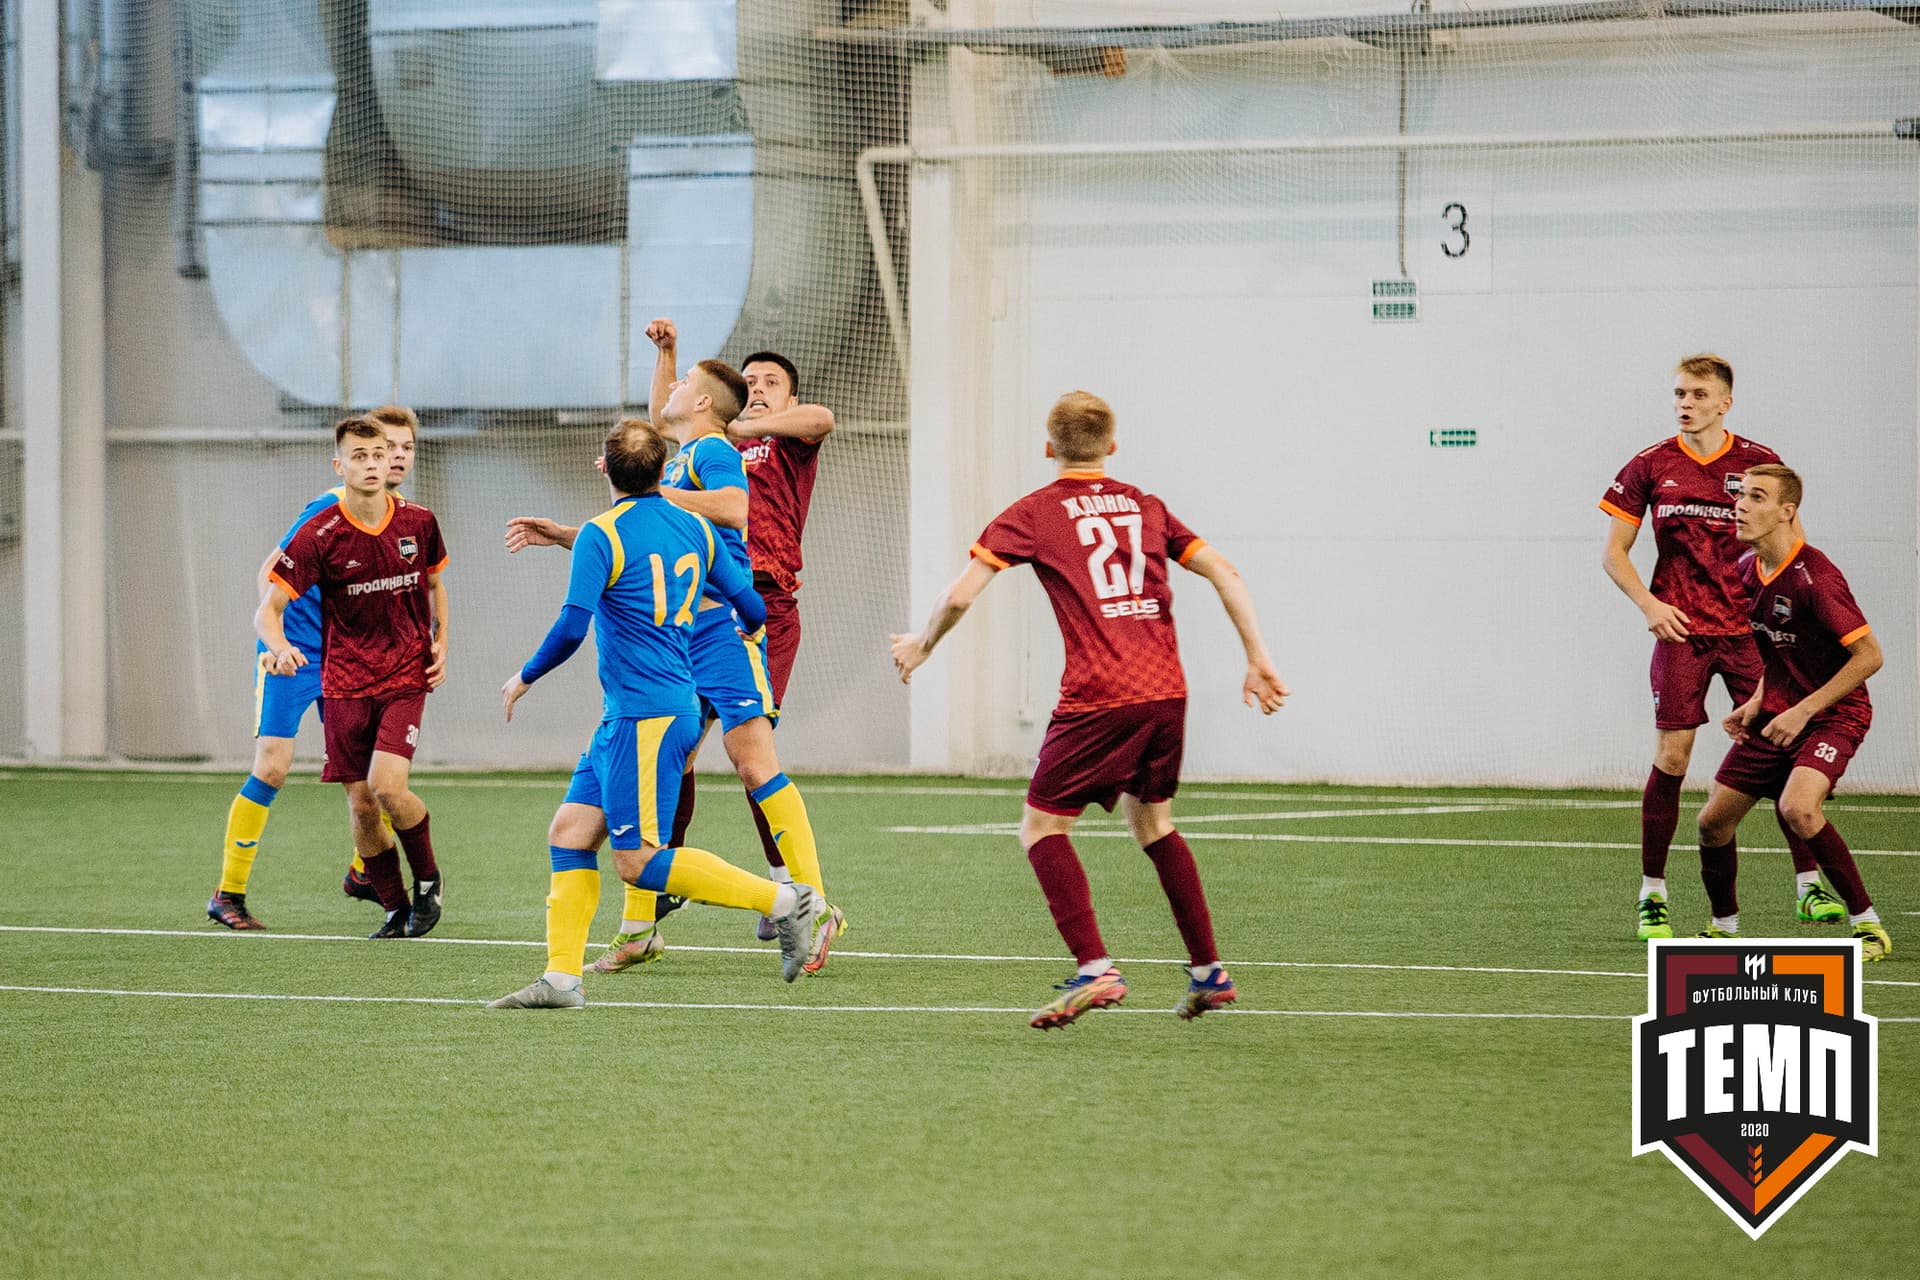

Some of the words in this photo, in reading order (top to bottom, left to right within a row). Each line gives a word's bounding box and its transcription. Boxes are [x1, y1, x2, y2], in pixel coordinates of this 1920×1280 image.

[1441, 203, 1470, 258] 3
[1657, 504, 1737, 519] ПРОДИНВЕС
[1076, 514, 1147, 600] 27
[649, 552, 699, 627] 12
[1814, 742, 1837, 763] 33
